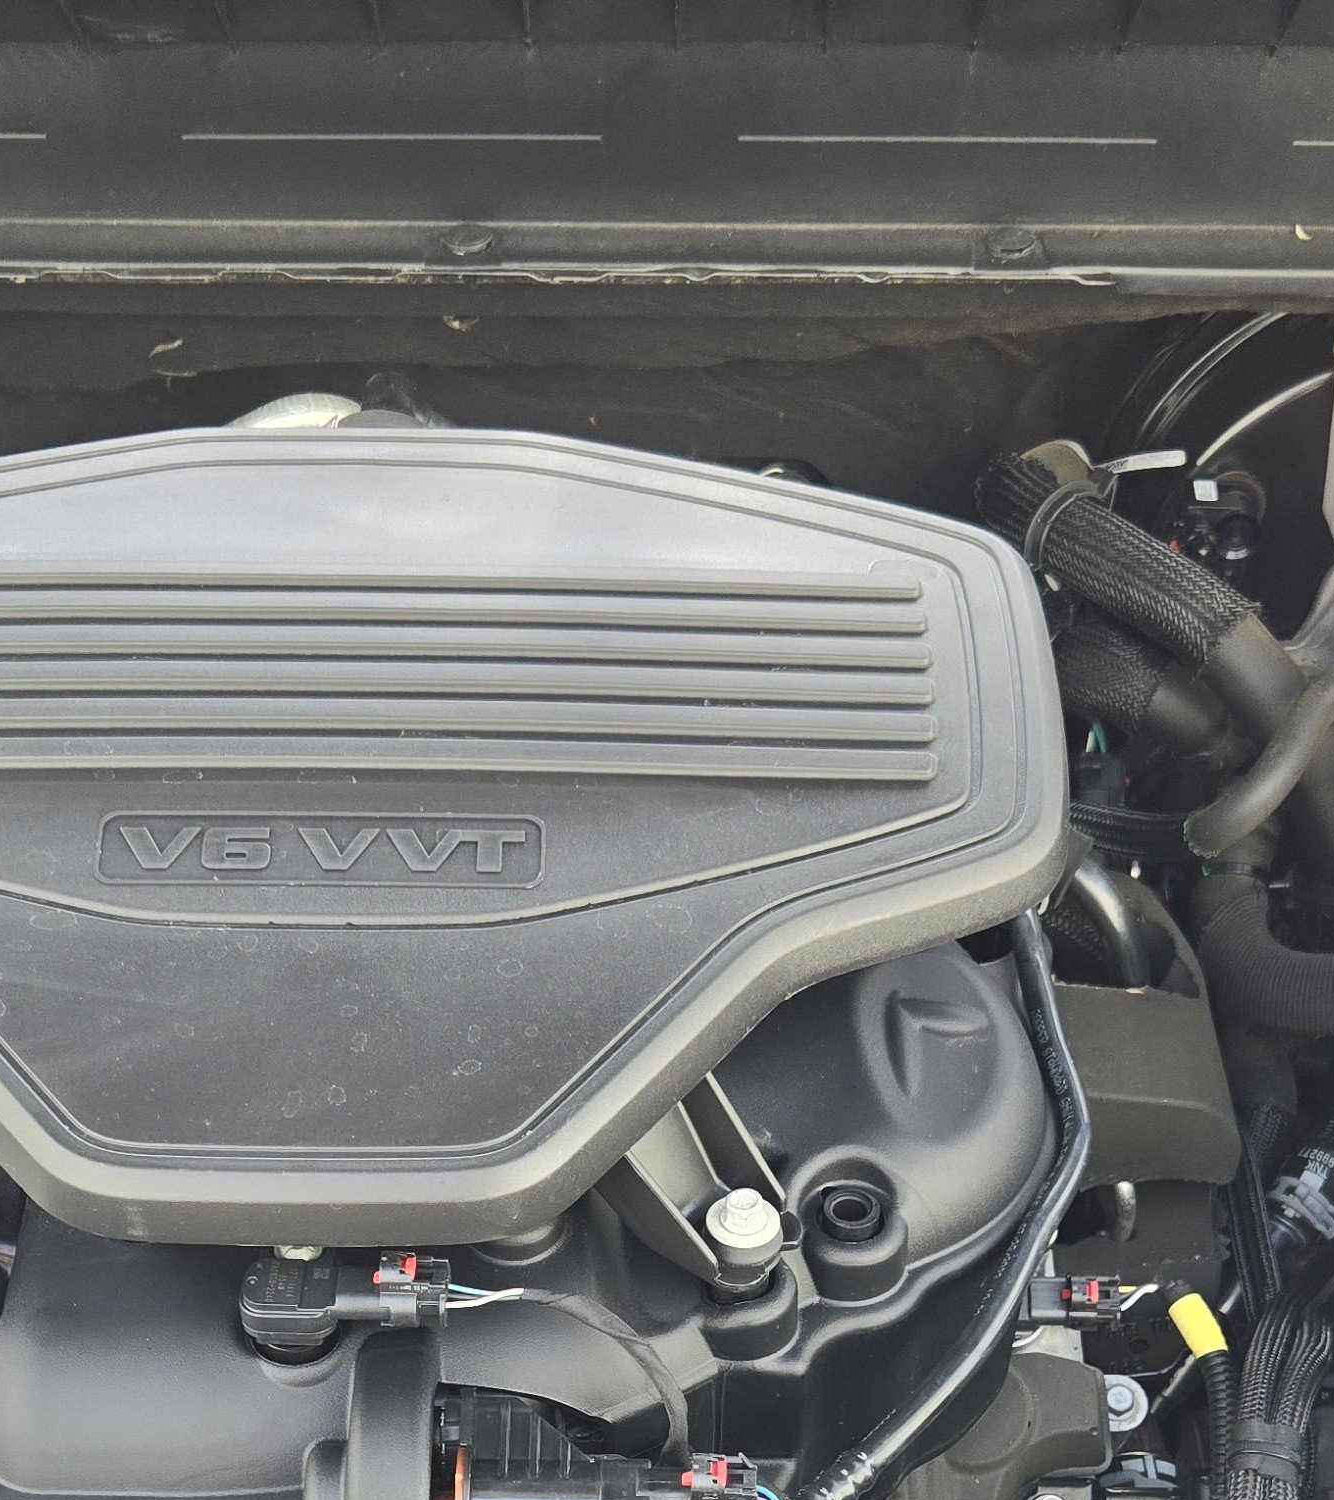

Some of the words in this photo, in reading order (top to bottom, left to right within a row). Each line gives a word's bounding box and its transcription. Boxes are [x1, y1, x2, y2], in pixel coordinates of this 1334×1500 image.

[119, 826, 271, 870] V6
[298, 827, 526, 873] VVT
[1303, 1159, 1329, 1179] TNK
